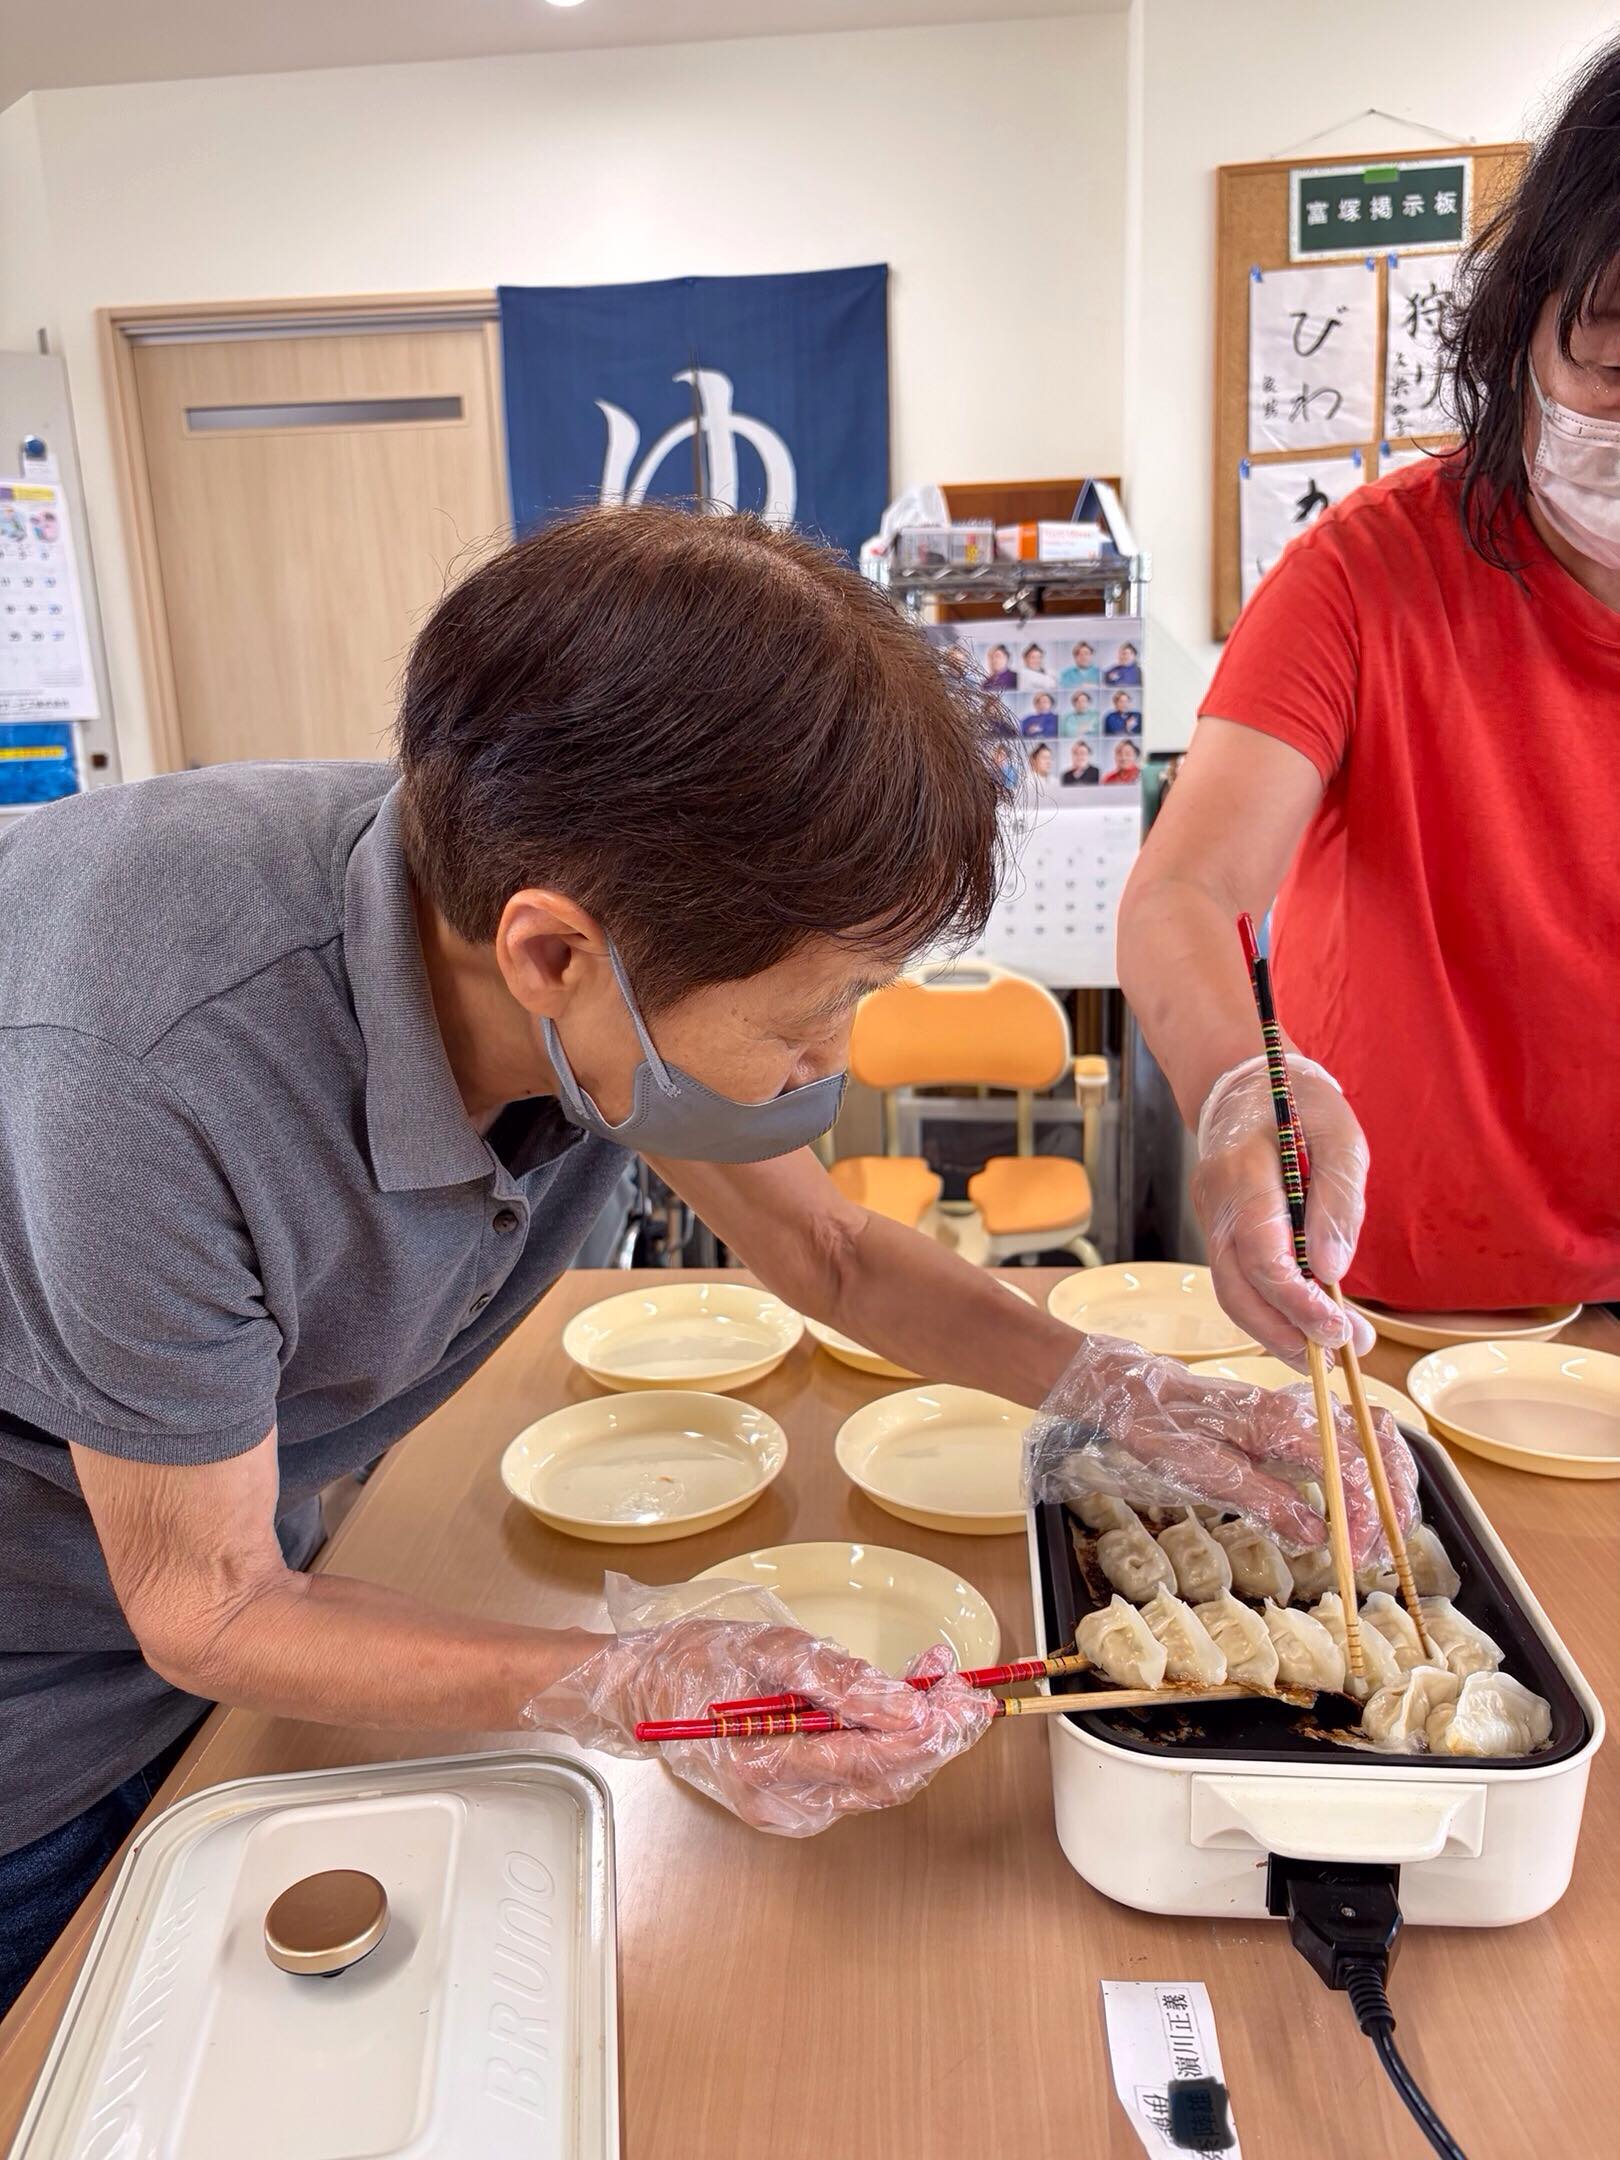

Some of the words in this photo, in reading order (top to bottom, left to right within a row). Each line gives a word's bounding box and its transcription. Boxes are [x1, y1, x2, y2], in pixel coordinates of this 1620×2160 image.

[1305, 190, 1458, 226] 富塚掲示板
[1289, 305, 1349, 424] びわ
[485, 1850, 555, 2121] BRUNO
